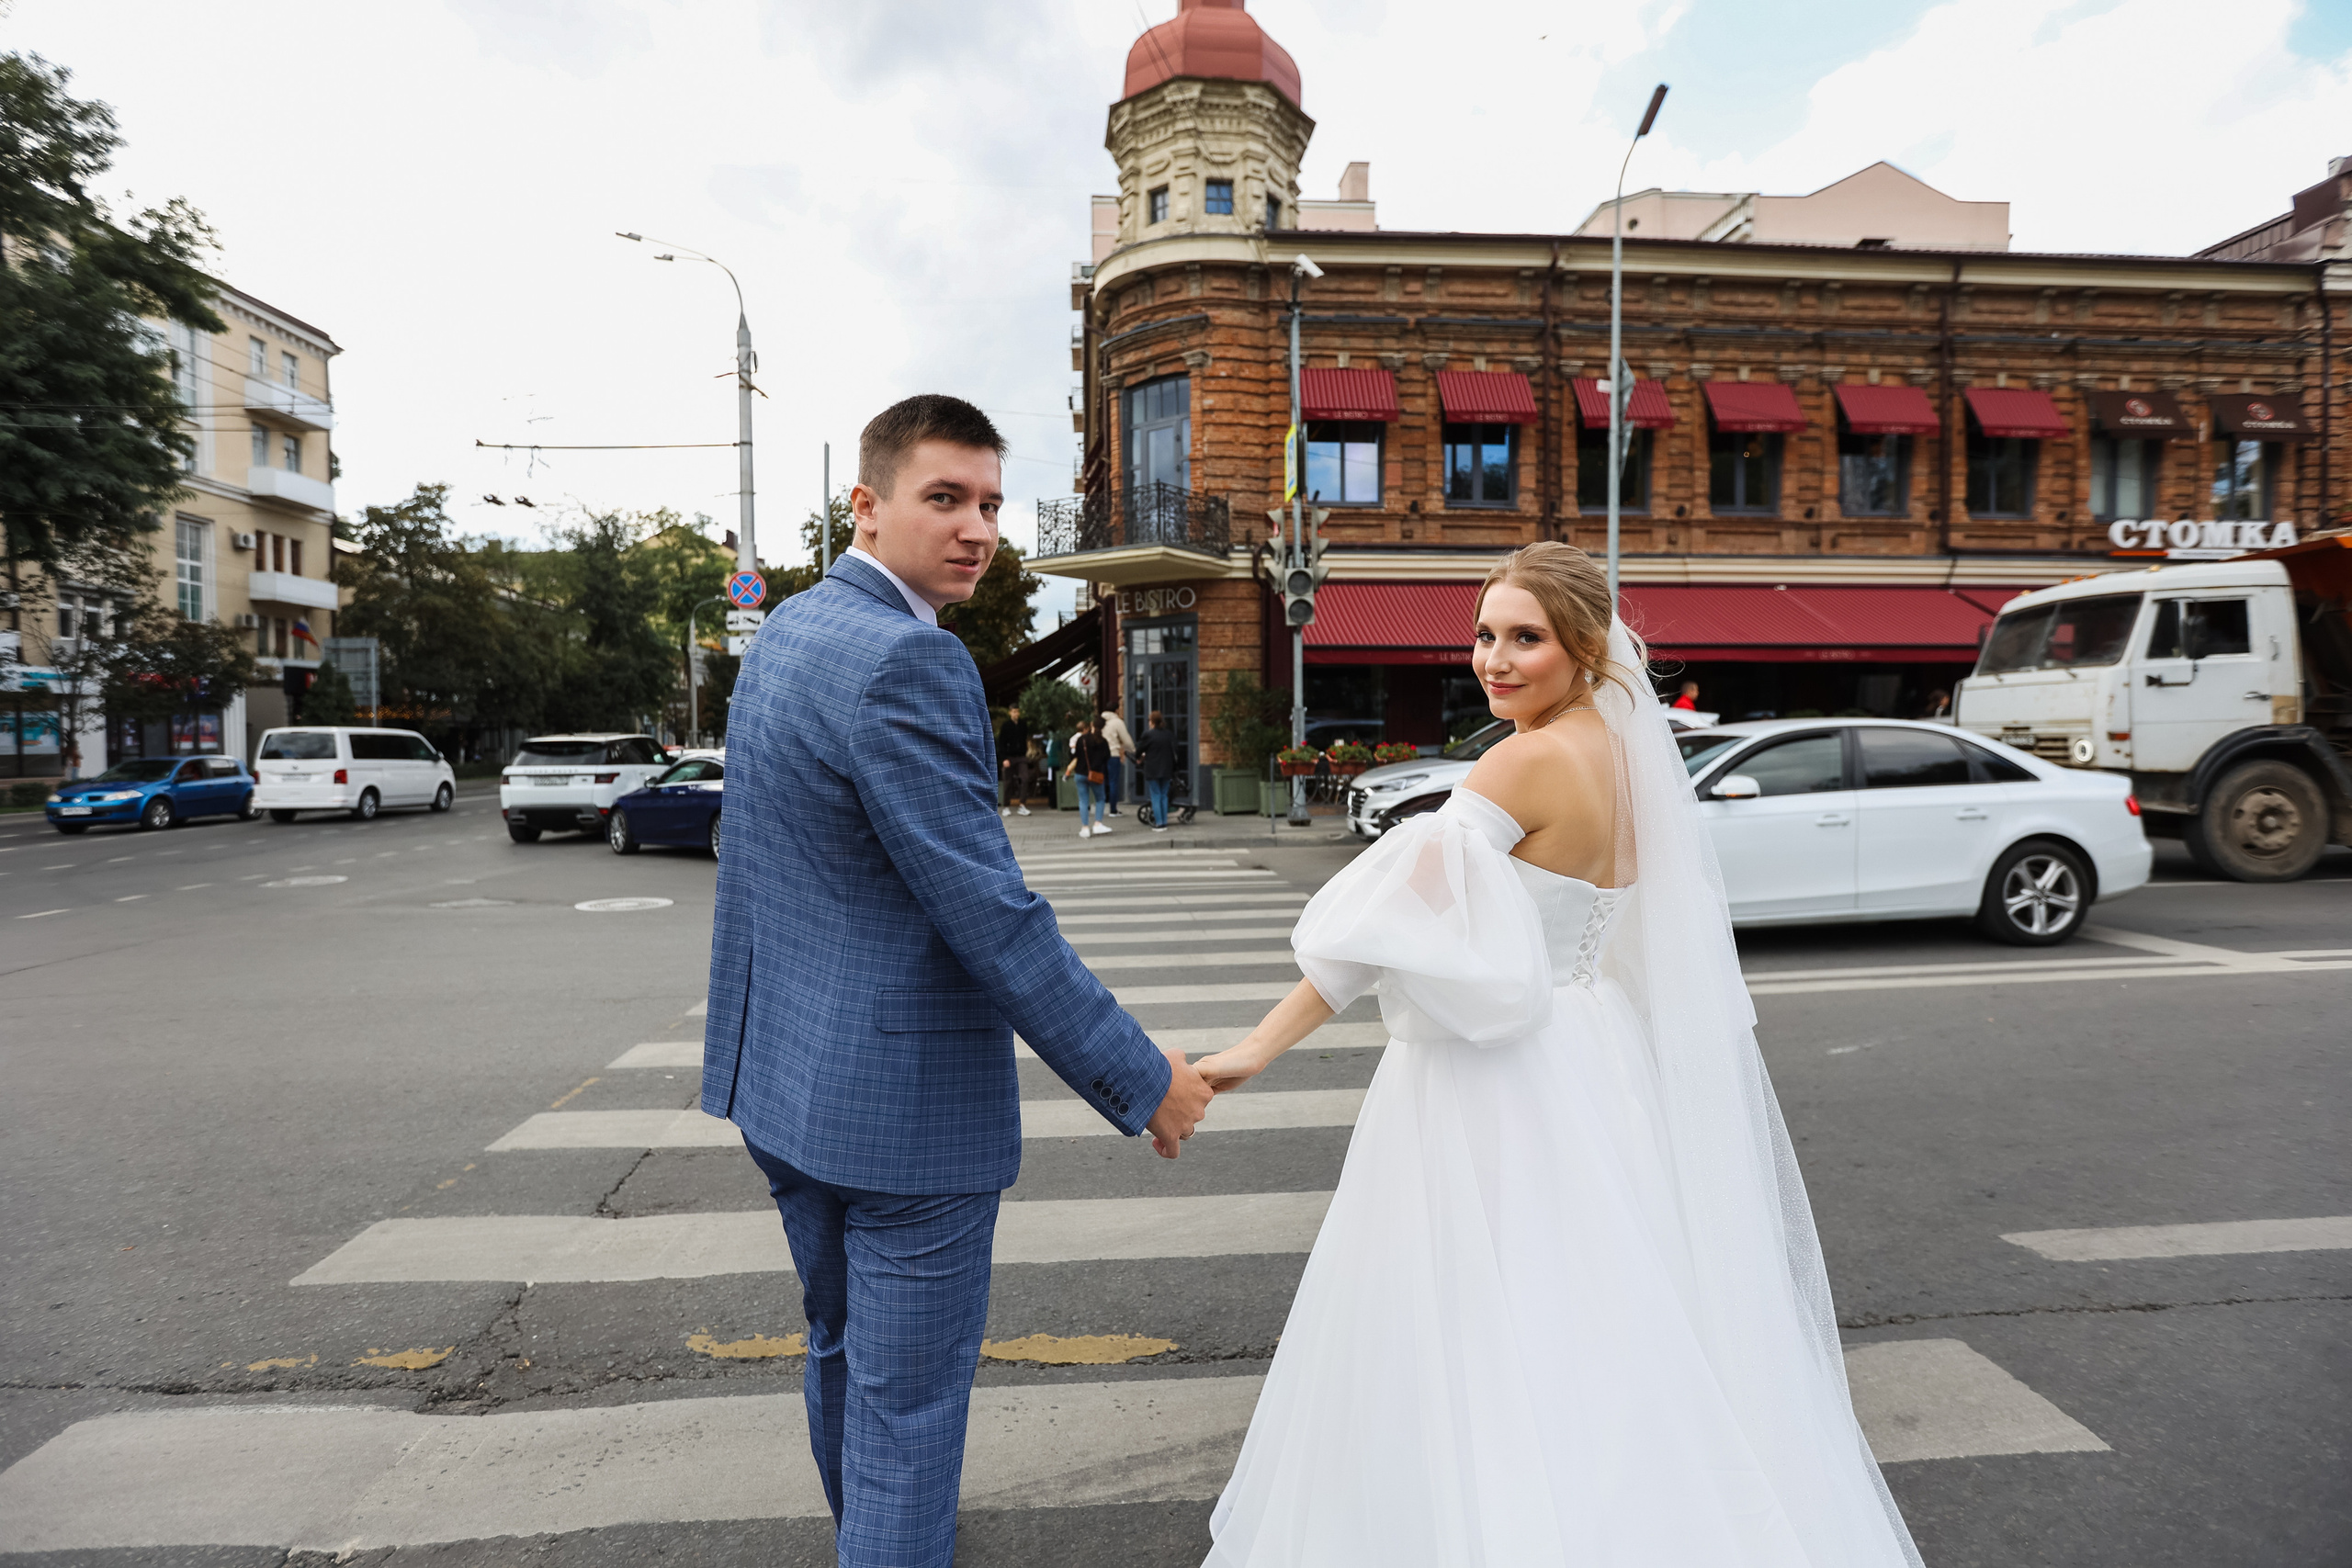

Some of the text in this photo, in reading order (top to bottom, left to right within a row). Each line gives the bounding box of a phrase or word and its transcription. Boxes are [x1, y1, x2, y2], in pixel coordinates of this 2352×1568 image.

[2108, 519, 2299, 548] СТОМКА
[1114, 587, 1196, 614] LE BISTRO
[1450, 652, 1474, 661] BISTR
